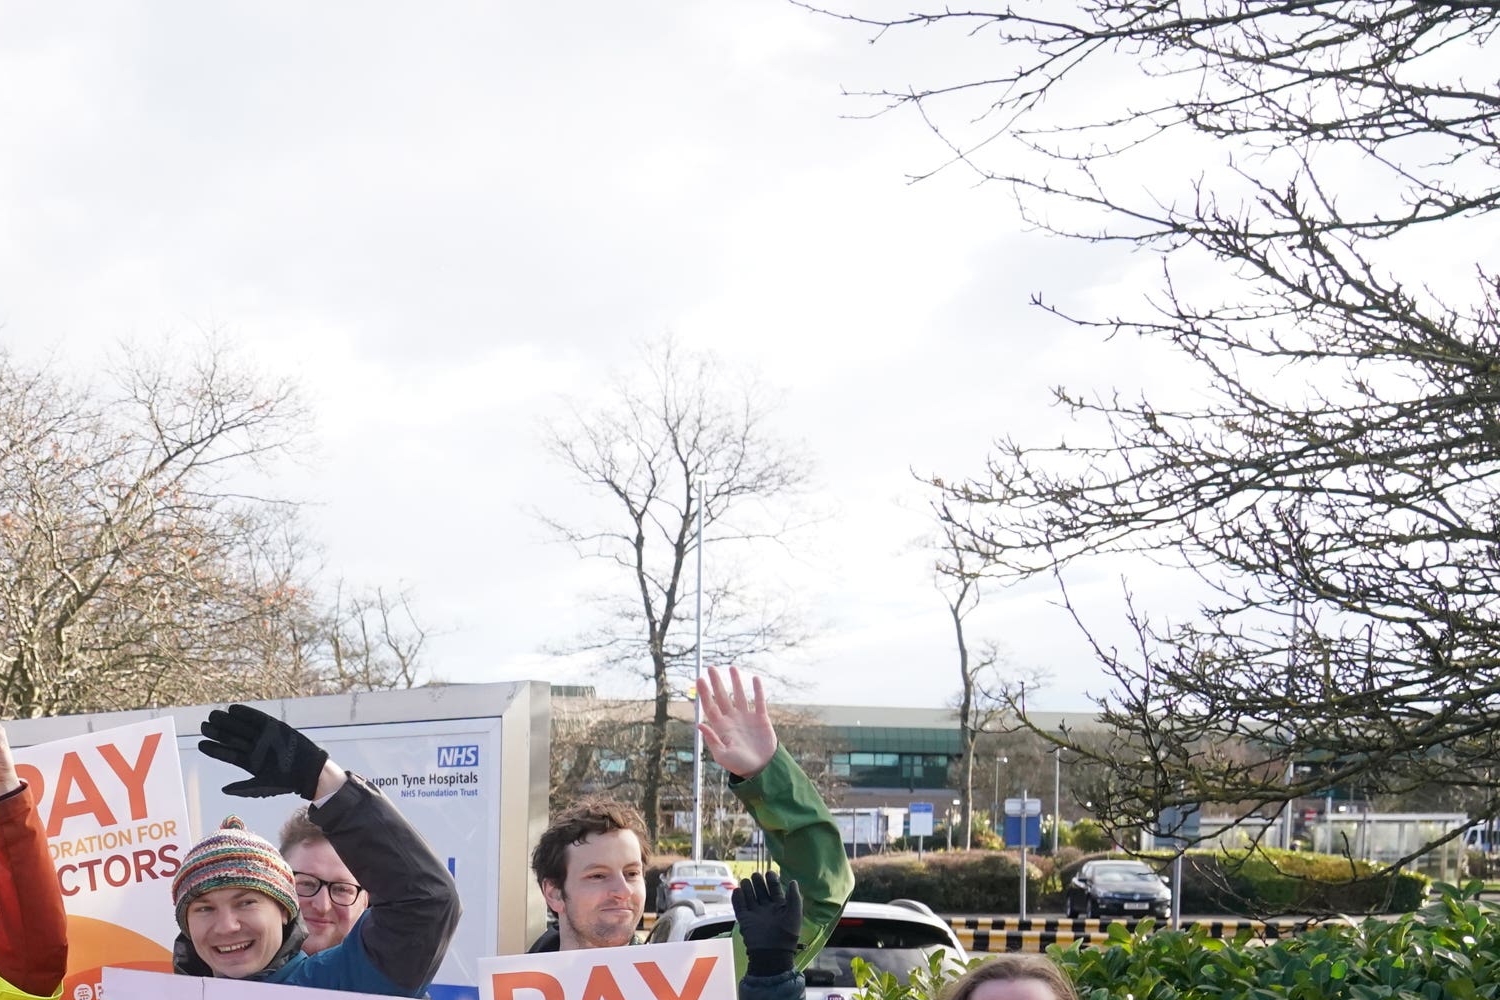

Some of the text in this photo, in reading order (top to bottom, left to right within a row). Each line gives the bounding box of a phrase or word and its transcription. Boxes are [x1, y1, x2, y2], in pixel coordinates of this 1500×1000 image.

[438, 746, 478, 767] NHS
[401, 774, 426, 788] Tyne
[429, 771, 478, 787] Hospitals
[401, 788, 478, 798] NHS Foundation Trust
[138, 820, 177, 840] FOR
[58, 844, 181, 897] CTORS
